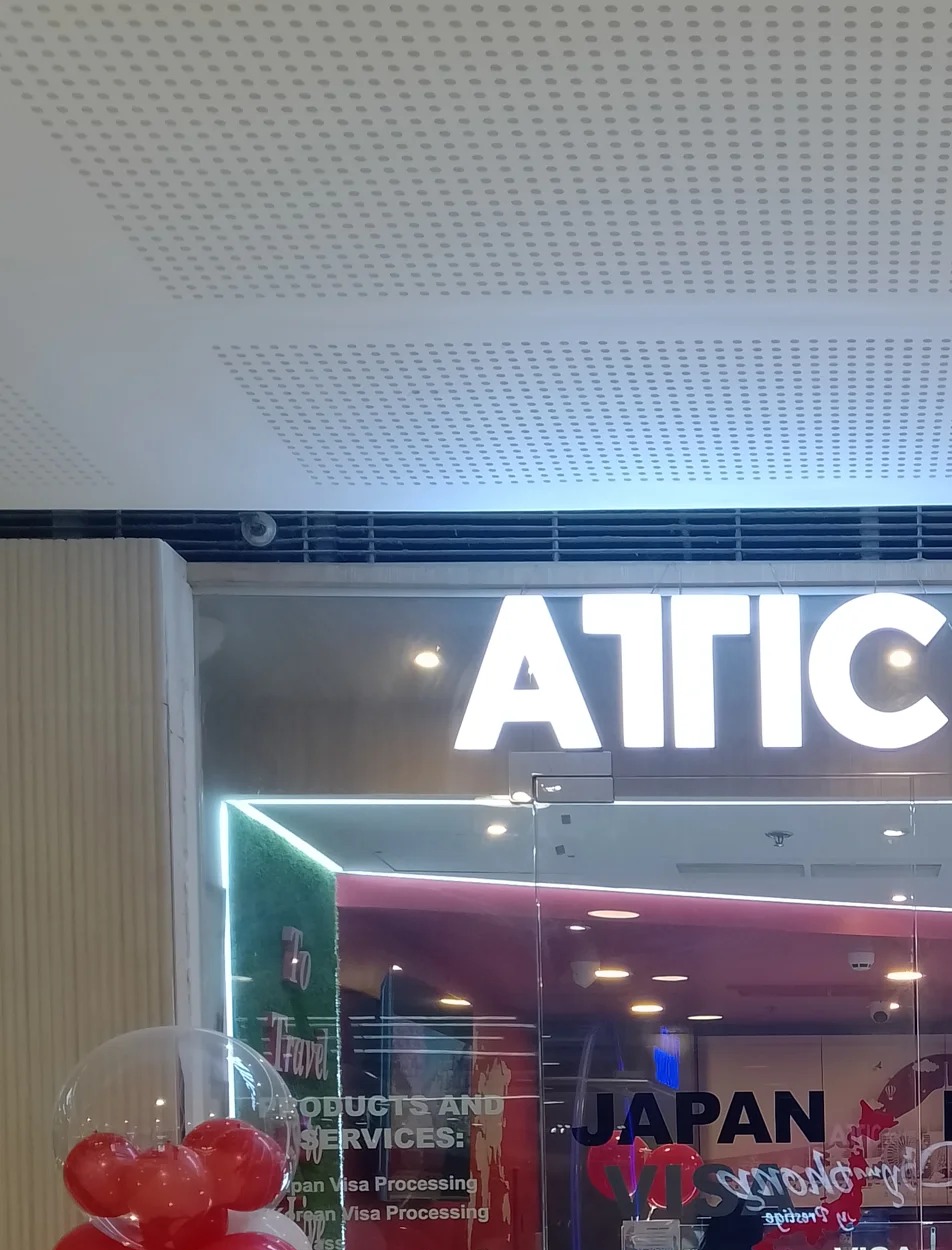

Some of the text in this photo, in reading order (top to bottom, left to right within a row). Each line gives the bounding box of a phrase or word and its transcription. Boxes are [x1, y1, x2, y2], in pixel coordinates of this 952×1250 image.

[454, 593, 948, 750] ATTIC
[271, 1011, 329, 1081] Travel
[437, 1094, 504, 1116] AND
[571, 1090, 826, 1146] JAPAN
[329, 1177, 369, 1193] Visa
[374, 1175, 478, 1193] Processing
[604, 1163, 794, 1218] VISA
[344, 1205, 380, 1221] Visa
[386, 1204, 489, 1223] Processing
